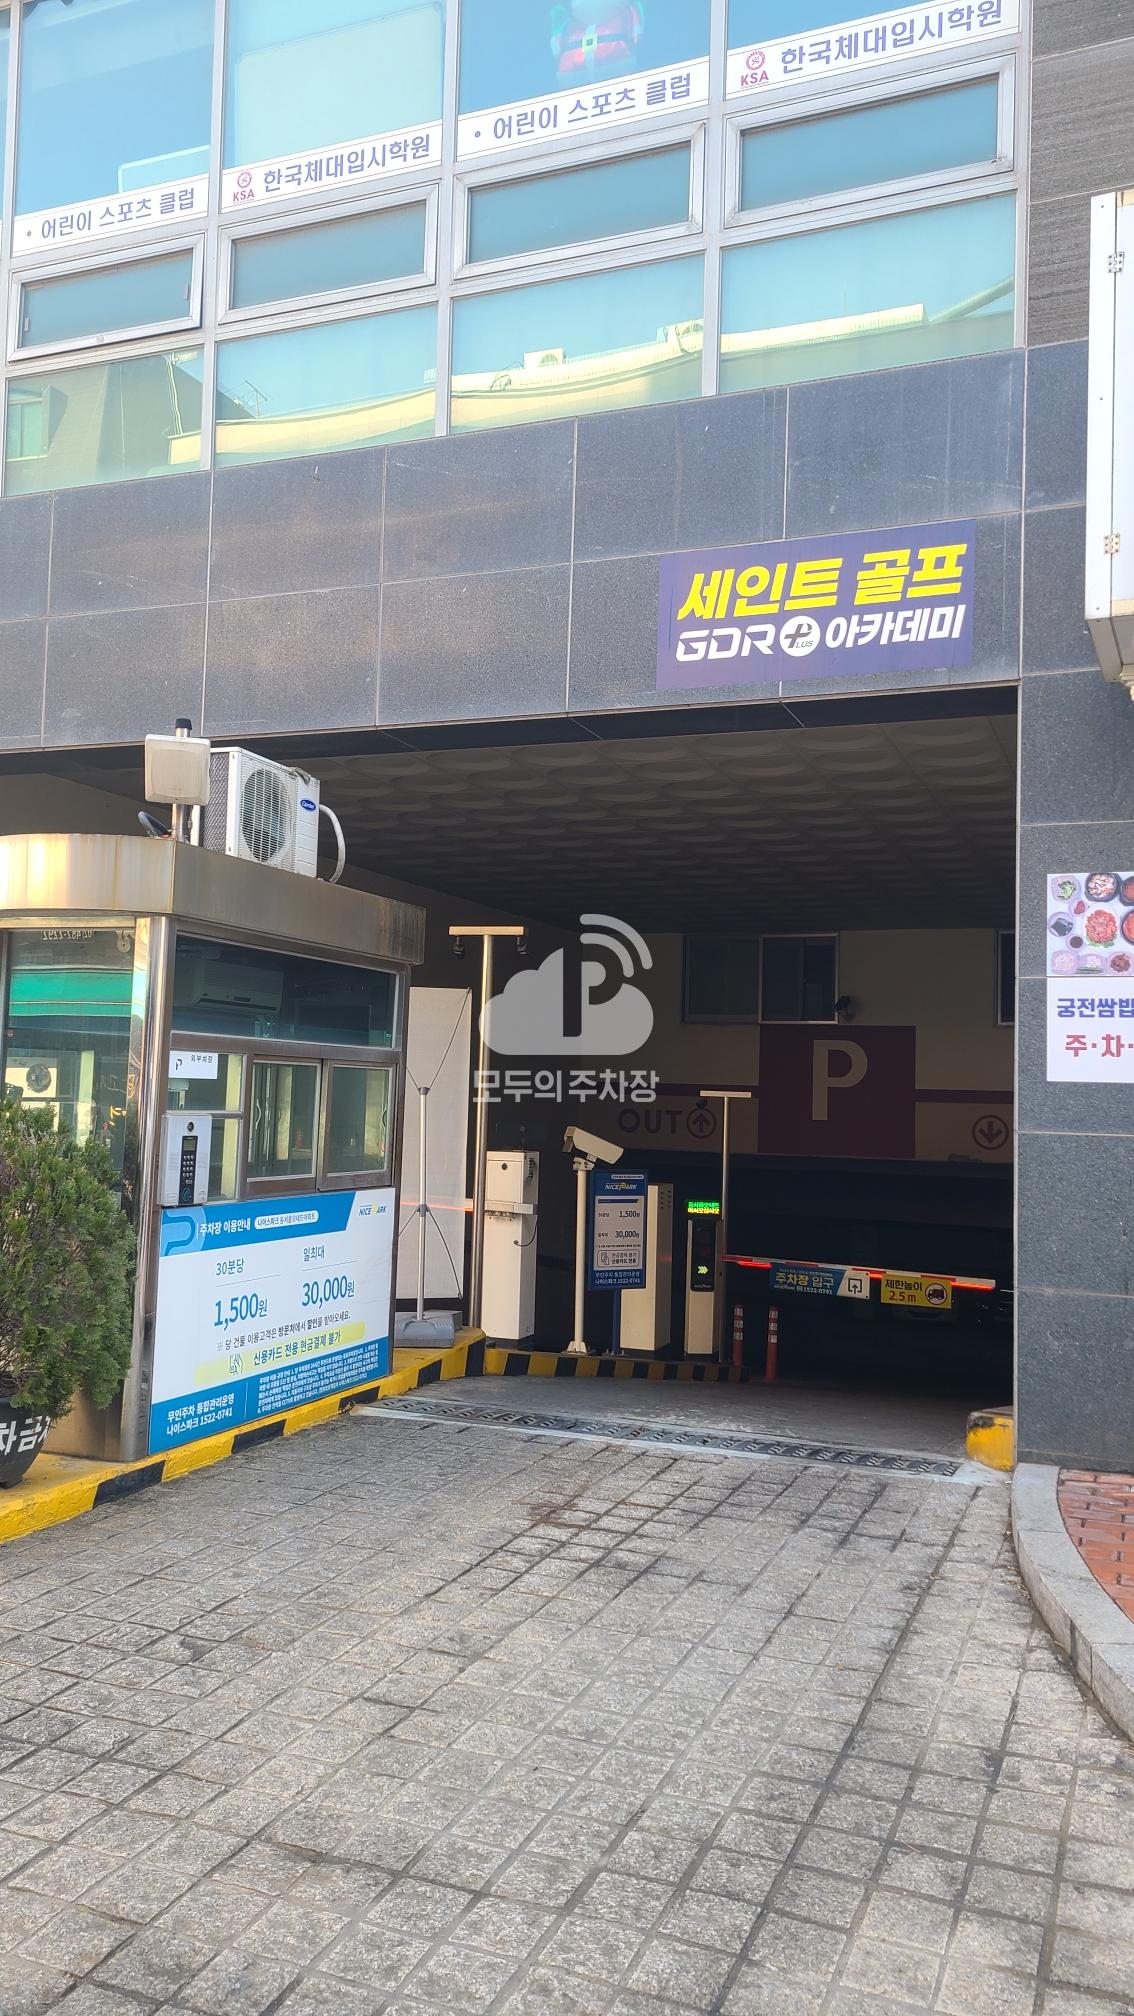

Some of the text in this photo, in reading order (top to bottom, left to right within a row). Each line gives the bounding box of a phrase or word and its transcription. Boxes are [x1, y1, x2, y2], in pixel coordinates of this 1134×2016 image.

[781, 0, 1003, 75] 한국체대입시학원
[740, 70, 769, 86] KSA
[492, 73, 692, 140] 어린이 스포츠 클럽
[263, 133, 431, 193] 한국체대입시학원
[232, 188, 255, 202] KSA
[41, 188, 195, 240] 어린이 스포츠 클럽
[677, 544, 968, 620] 세인트 골프
[675, 623, 776, 662] GDR
[825, 604, 967, 649] 아카데미
[812, 1039, 868, 1121] P
[617, 1107, 683, 1136] OUT
[199, 1217, 251, 1236] 주차장 이용안내
[215, 1258, 245, 1276] 30분당
[303, 1246, 325, 1262] 일최대
[301, 1275, 355, 1309] 30,000원
[776, 1272, 809, 1286] 주차장
[812, 1276, 835, 1289] 입구
[885, 1278, 923, 1292] 제한높이
[214, 1293, 268, 1331] 1,500원
[225, 1338, 232, 1350] 당
[233, 1336, 246, 1349] 건물
[253, 1346, 283, 1367] 신용카드
[284, 1342, 299, 1358] 전용
[300, 1336, 327, 1356] 현금결제
[166, 1408, 233, 1437] 나이스파크 1522-0741
[167, 1393, 235, 1423] 무인주차 통합관리운영
